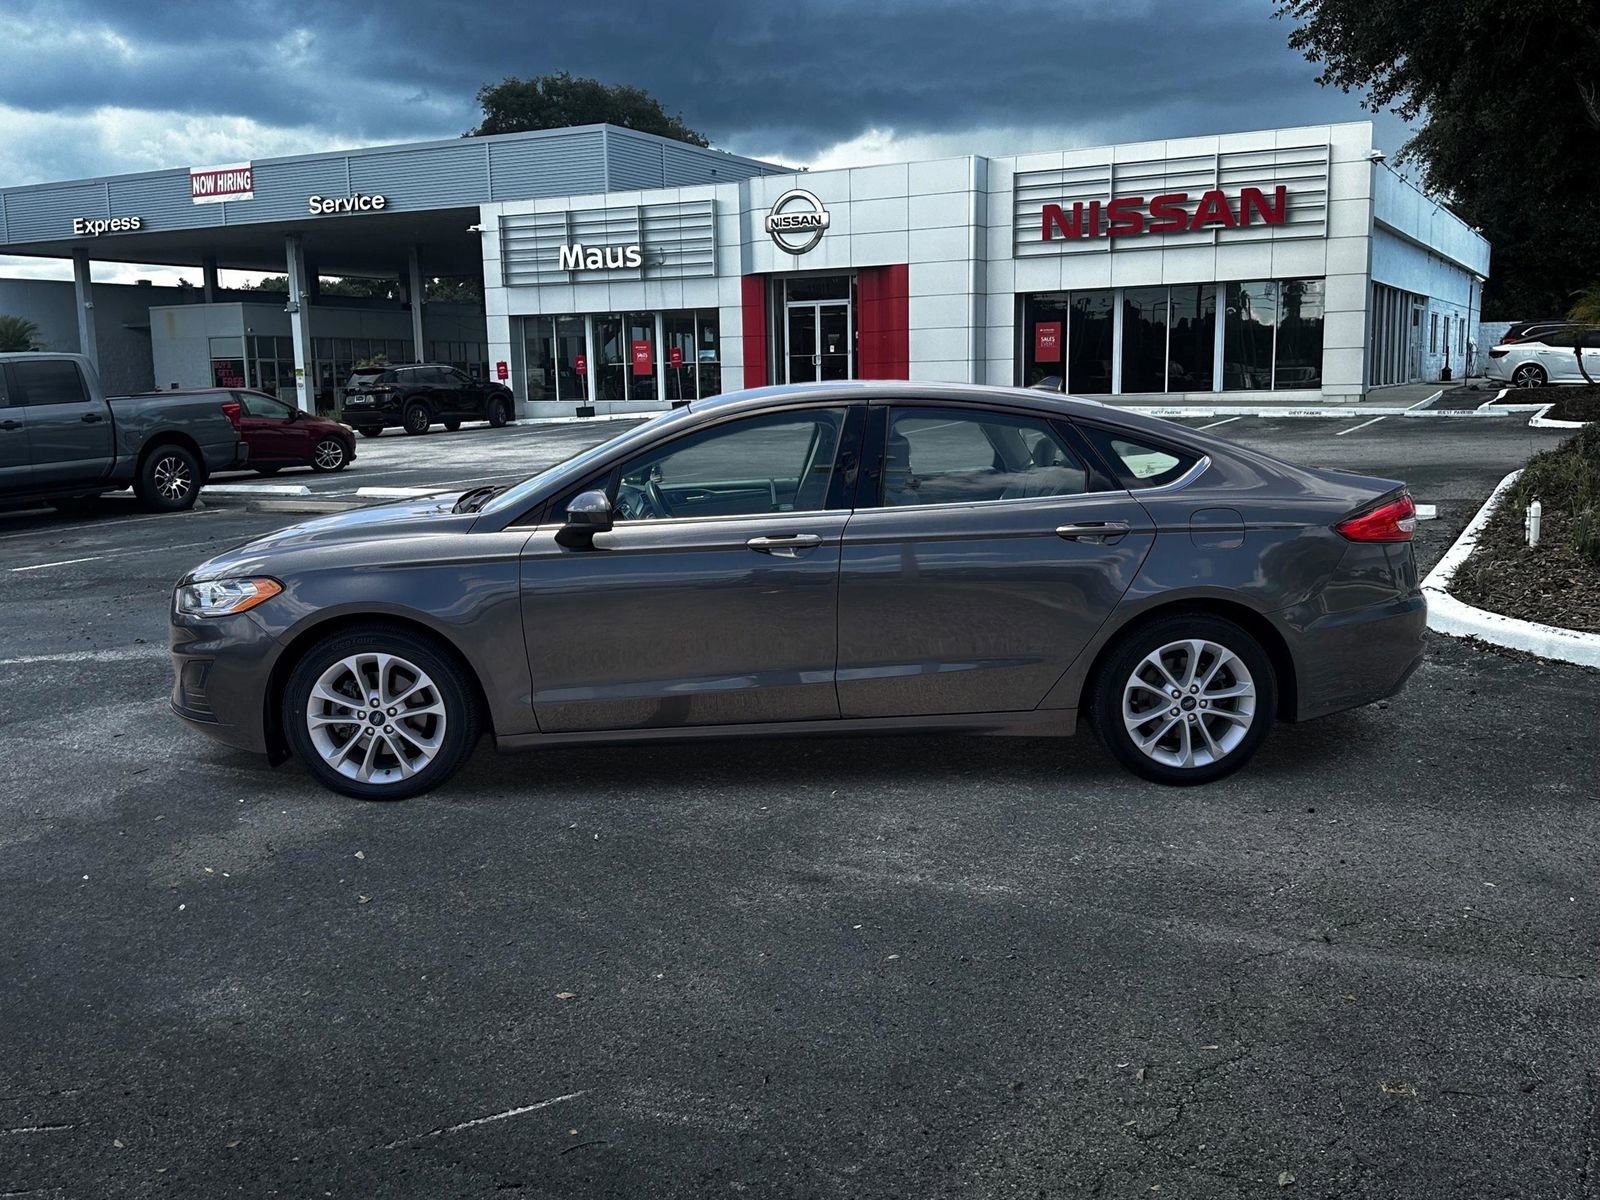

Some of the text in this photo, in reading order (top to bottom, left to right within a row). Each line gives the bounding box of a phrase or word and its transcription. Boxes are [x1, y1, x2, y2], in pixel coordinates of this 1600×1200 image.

[193, 171, 250, 194] NOW HIRING
[309, 193, 385, 214] Service
[1042, 185, 1287, 241] NISSAN
[73, 217, 140, 236] Express
[770, 215, 822, 228] NISSAN
[560, 244, 642, 270] Maus
[223, 377, 244, 386] FREE
